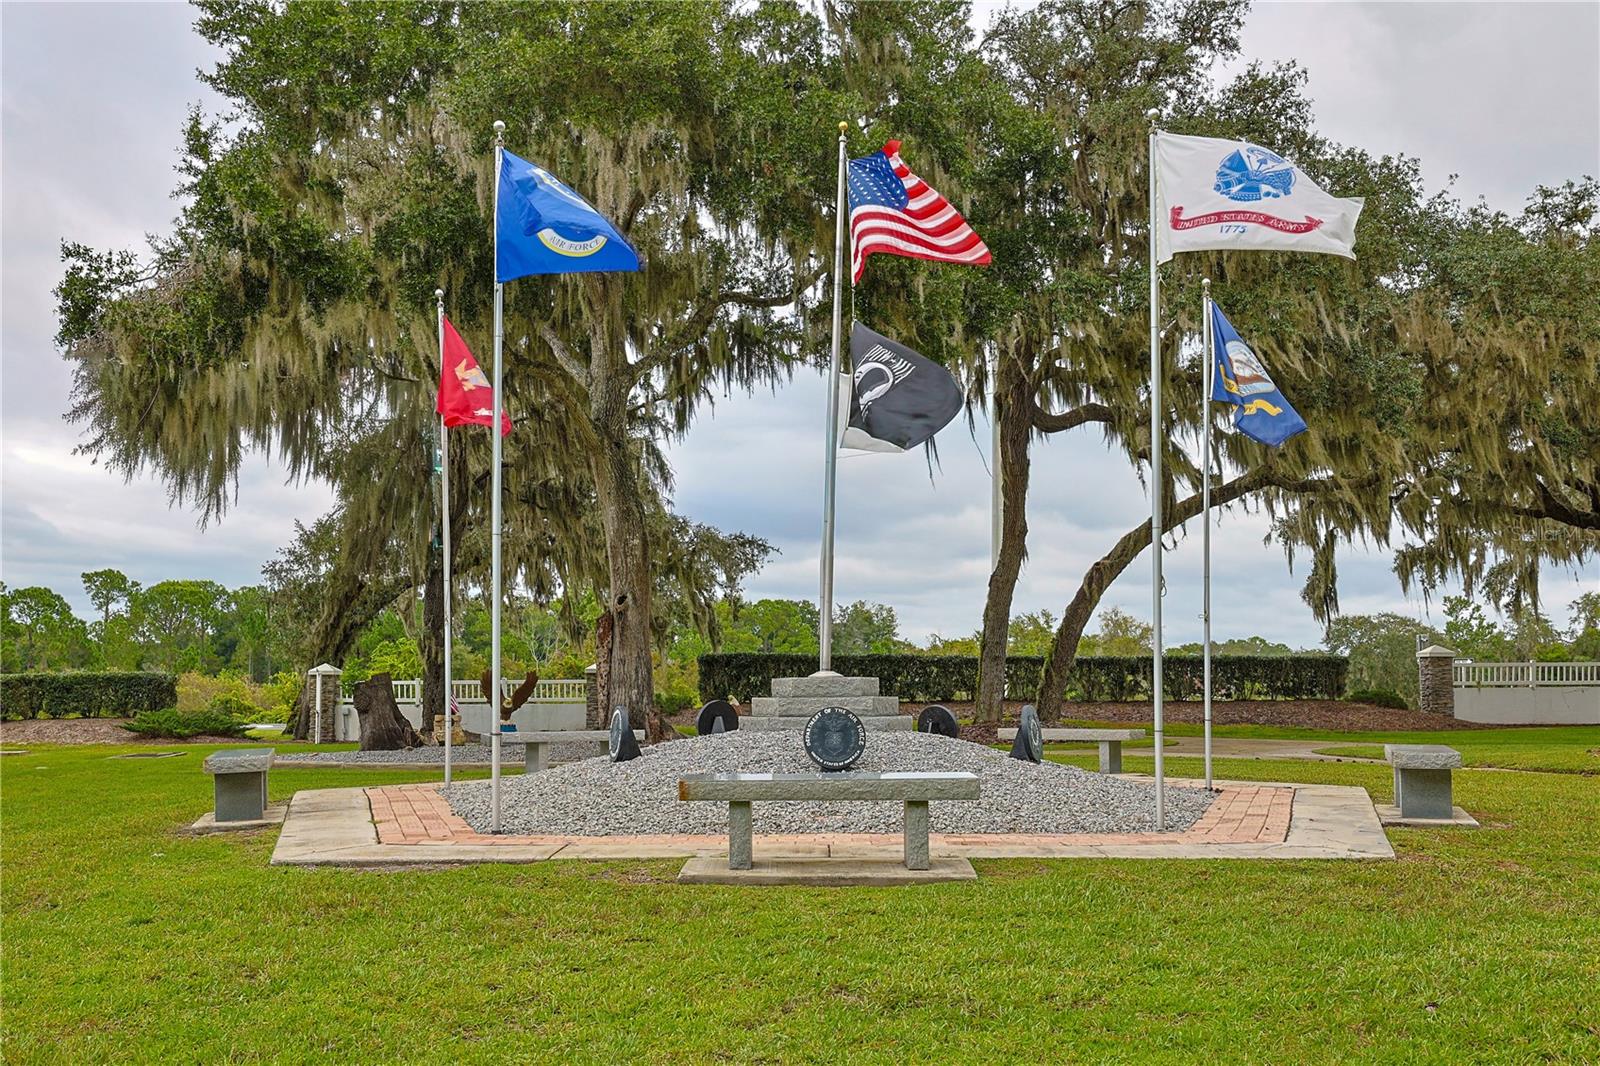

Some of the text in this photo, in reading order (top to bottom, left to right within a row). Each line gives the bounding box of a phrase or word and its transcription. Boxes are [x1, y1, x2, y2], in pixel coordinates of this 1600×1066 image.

[1177, 213, 1307, 231] UNITED STATES ARMY
[1220, 225, 1247, 233] 1775
[551, 236, 566, 249] AIR
[848, 713, 858, 723] AIR
[857, 724, 865, 746] FORCE
